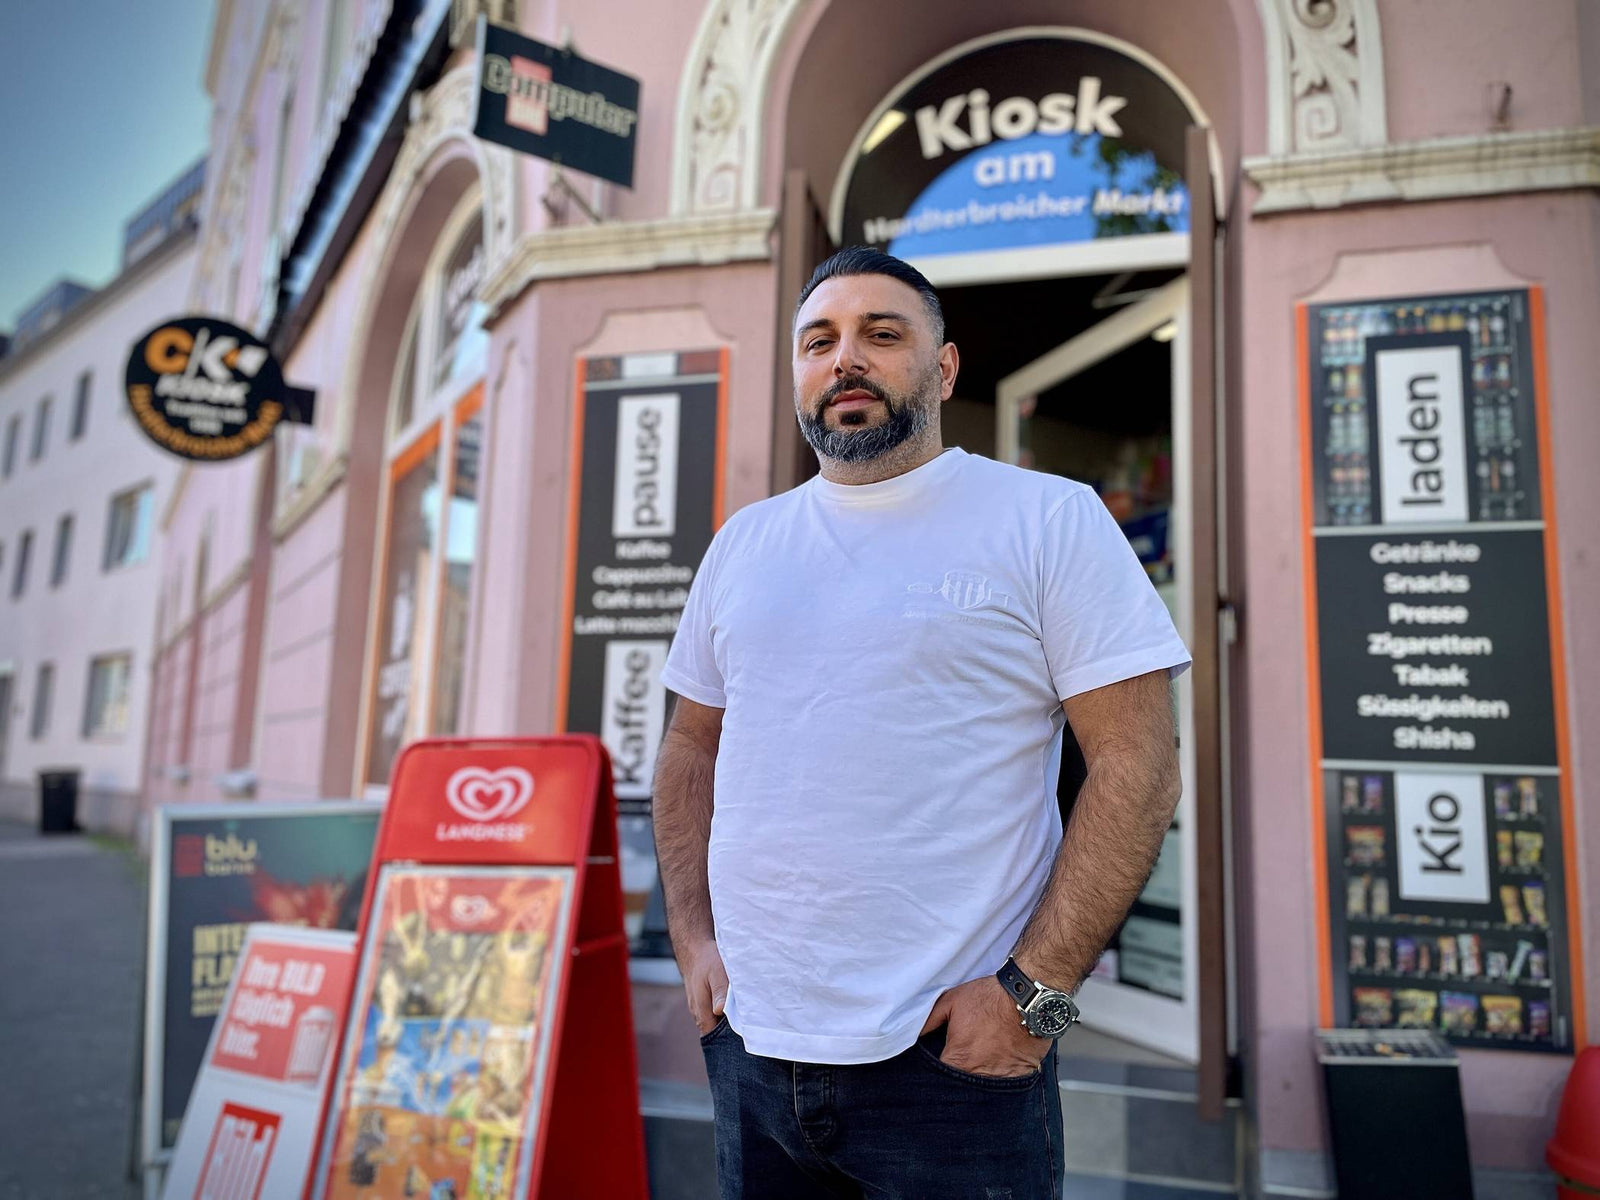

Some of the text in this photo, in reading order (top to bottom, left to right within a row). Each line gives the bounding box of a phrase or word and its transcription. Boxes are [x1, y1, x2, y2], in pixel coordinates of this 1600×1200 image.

[915, 76, 1128, 160] Kiosk
[974, 151, 1055, 187] am
[1091, 188, 1185, 217] Markt
[1397, 372, 1444, 507] laden
[632, 407, 662, 528] pause
[615, 540, 672, 560] Kaffee
[1370, 540, 1481, 564] Getränke
[592, 563, 693, 588] Cappuccino
[1383, 571, 1471, 594] Snacks
[574, 612, 681, 634] Latte macchi
[1388, 602, 1469, 624] Presse
[1367, 632, 1493, 659] Zigaretten
[1392, 663, 1469, 687] Tabak
[613, 649, 651, 785] Kaffee
[1357, 694, 1510, 721] Süssigkeiten
[1393, 725, 1476, 750] Shisha
[205, 832, 258, 862] blu
[1414, 792, 1465, 877] Kio
[193, 923, 248, 955] INTE
[192, 957, 236, 986] FLA
[278, 958, 326, 996] BILD
